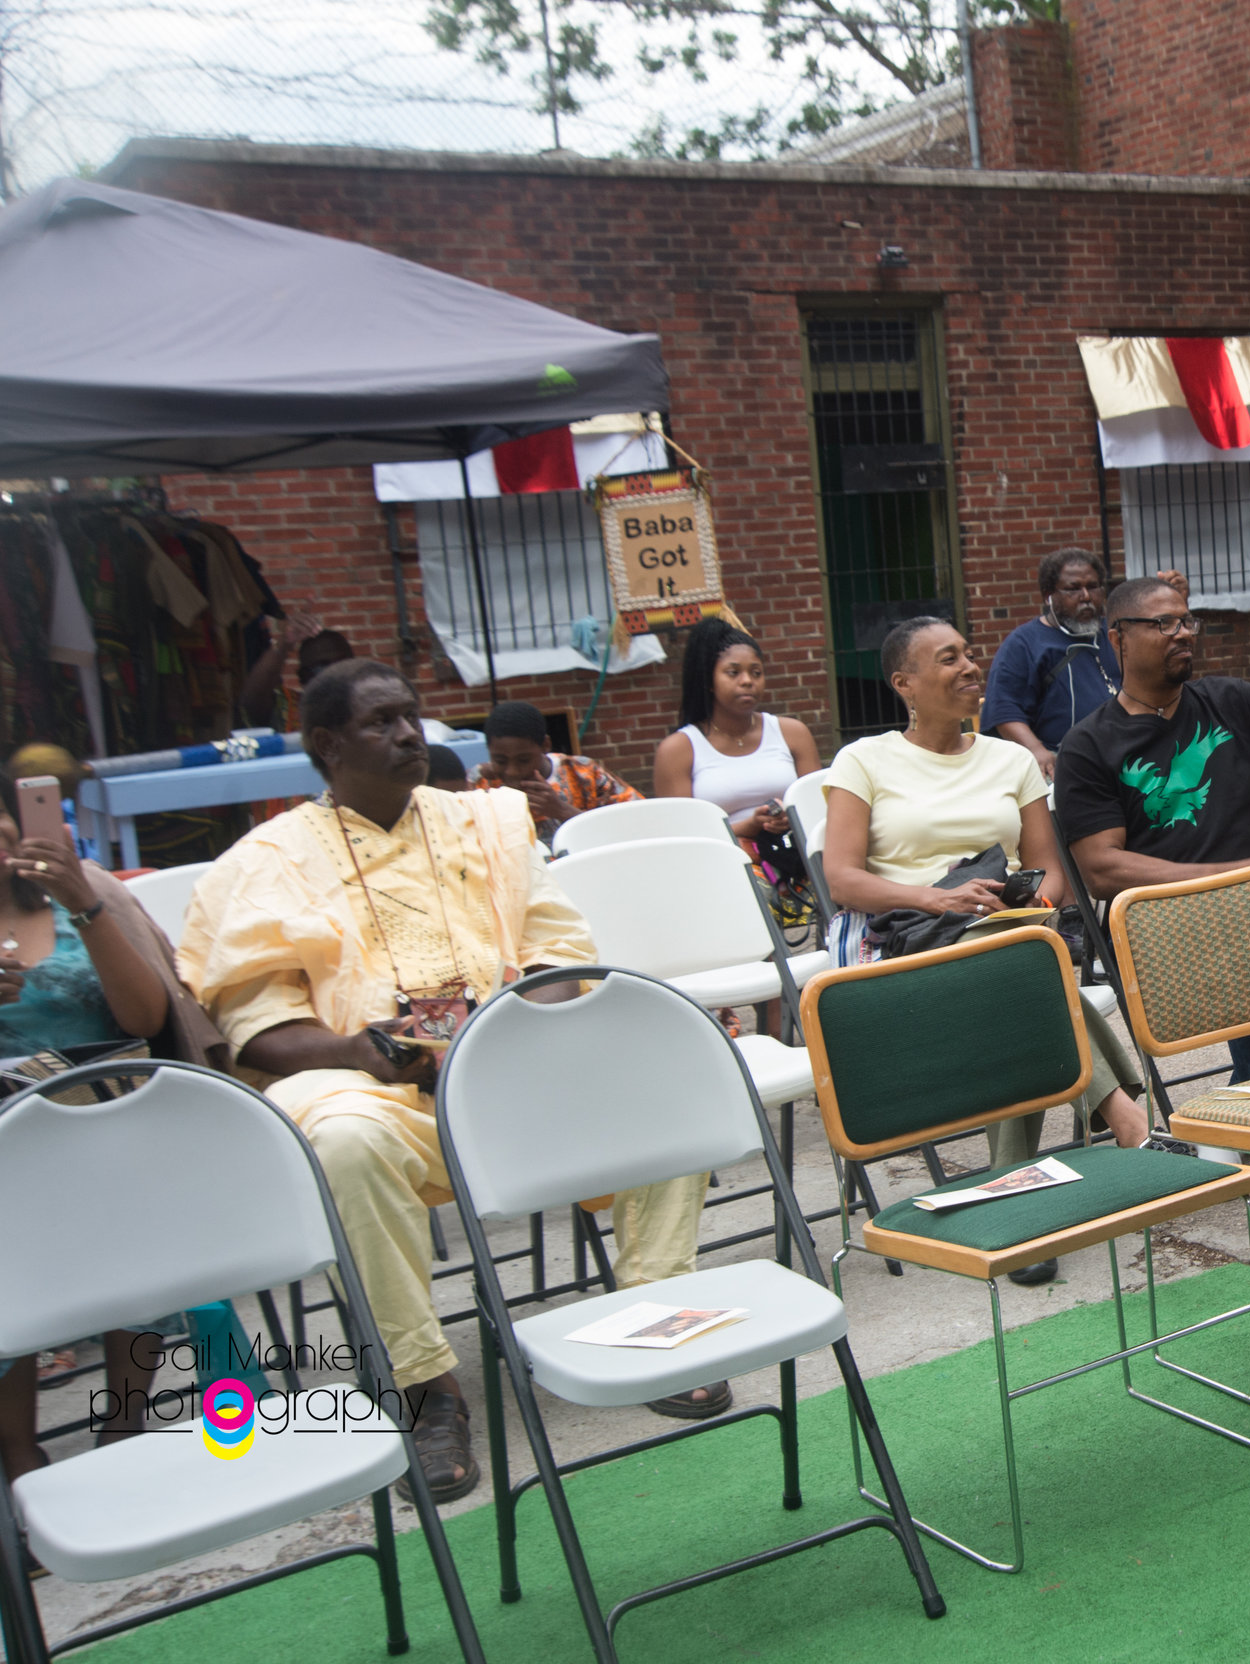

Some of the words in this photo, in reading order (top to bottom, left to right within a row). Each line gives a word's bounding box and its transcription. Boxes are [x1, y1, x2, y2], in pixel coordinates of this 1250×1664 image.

[624, 514, 694, 539] Baba
[638, 544, 689, 569] Got
[657, 576, 679, 598] It
